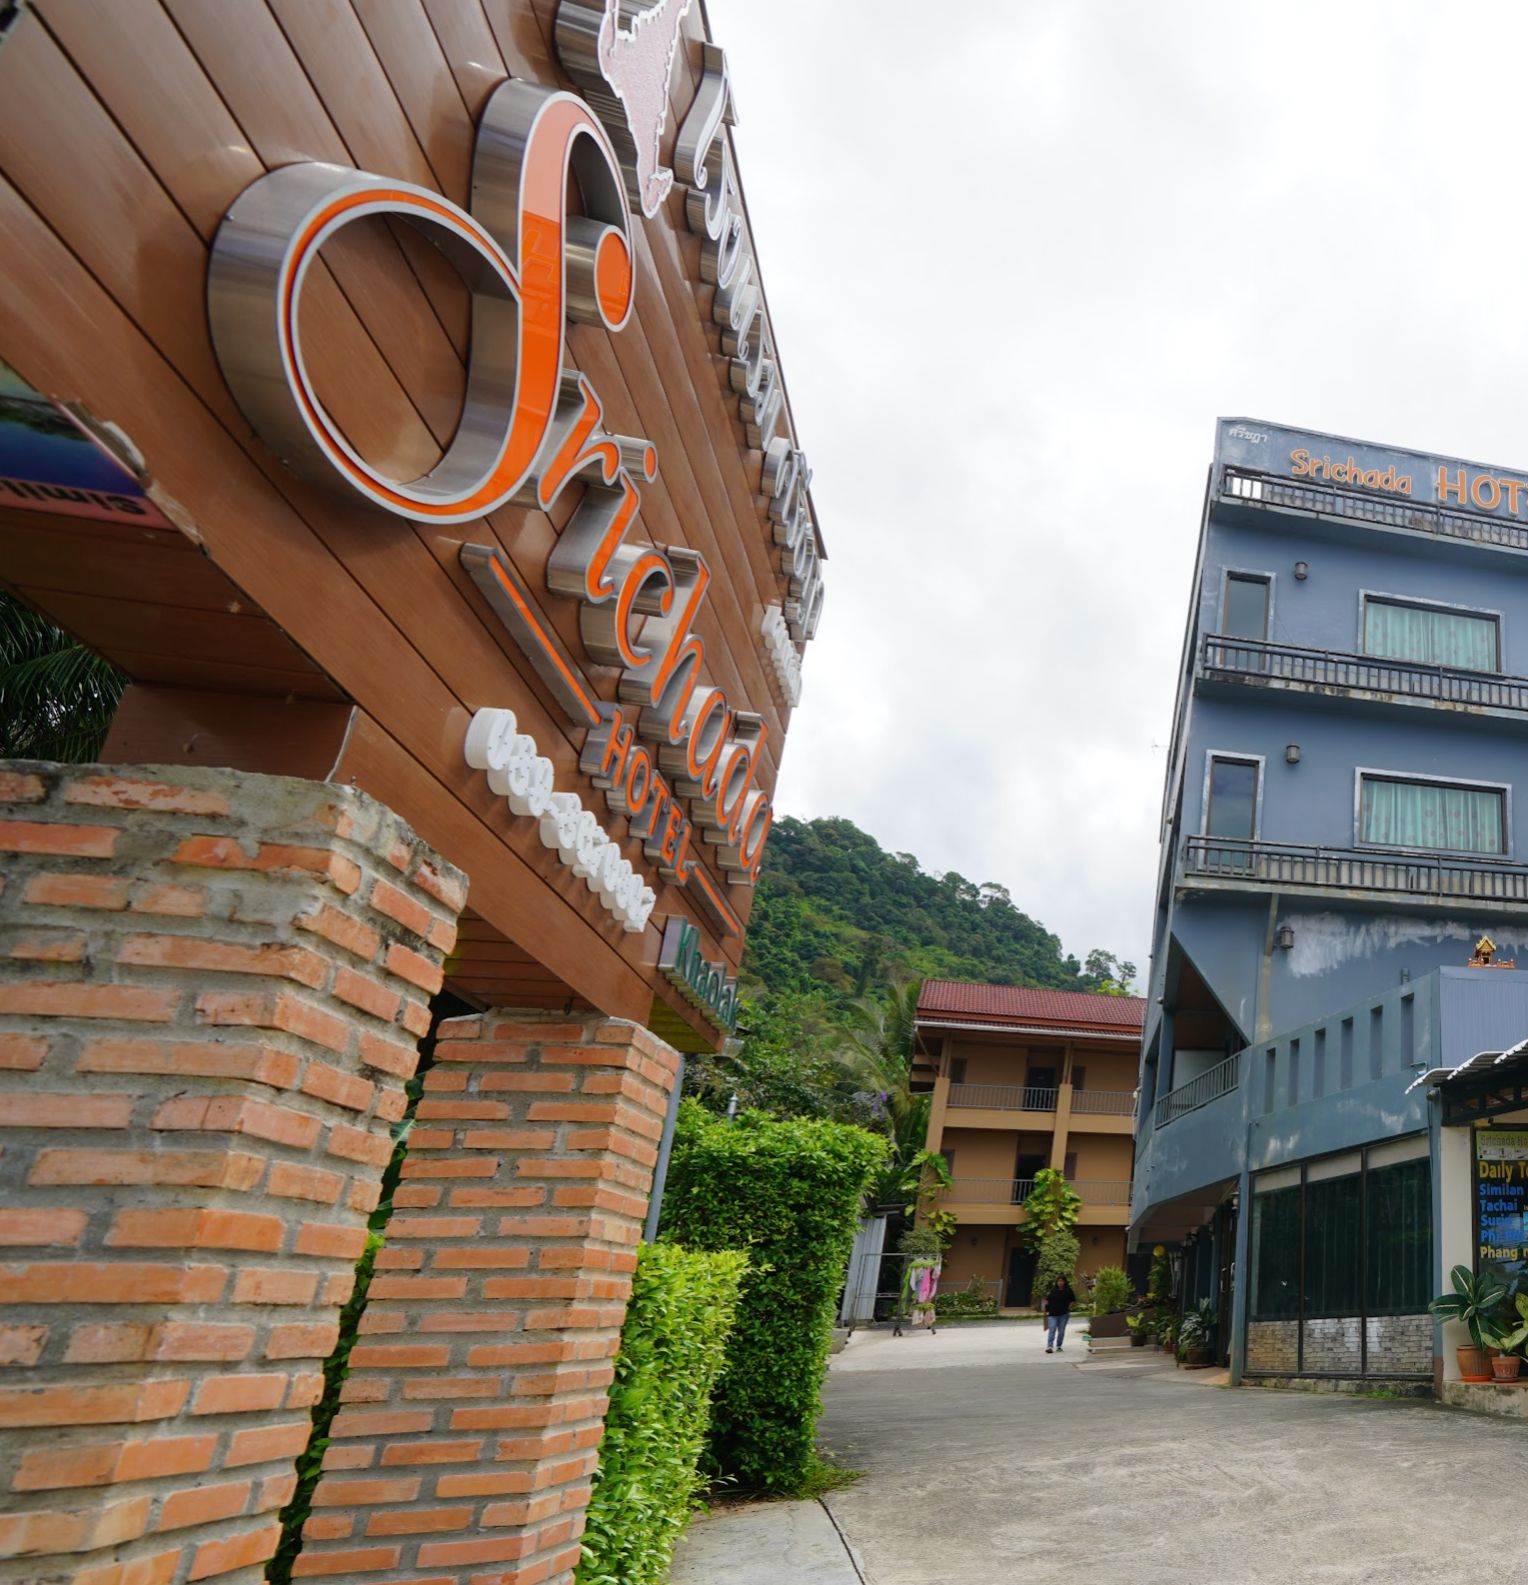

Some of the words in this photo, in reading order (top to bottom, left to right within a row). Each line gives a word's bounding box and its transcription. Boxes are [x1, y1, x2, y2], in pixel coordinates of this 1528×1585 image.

[1290, 448, 1413, 497] Srichada
[240, 83, 773, 888] Srichada
[594, 704, 694, 888] HOTEL
[1479, 1161, 1514, 1183] Daily
[1479, 1184, 1525, 1196] Similan
[1480, 1199, 1518, 1212] Tachai
[1480, 1245, 1518, 1261] Phang
